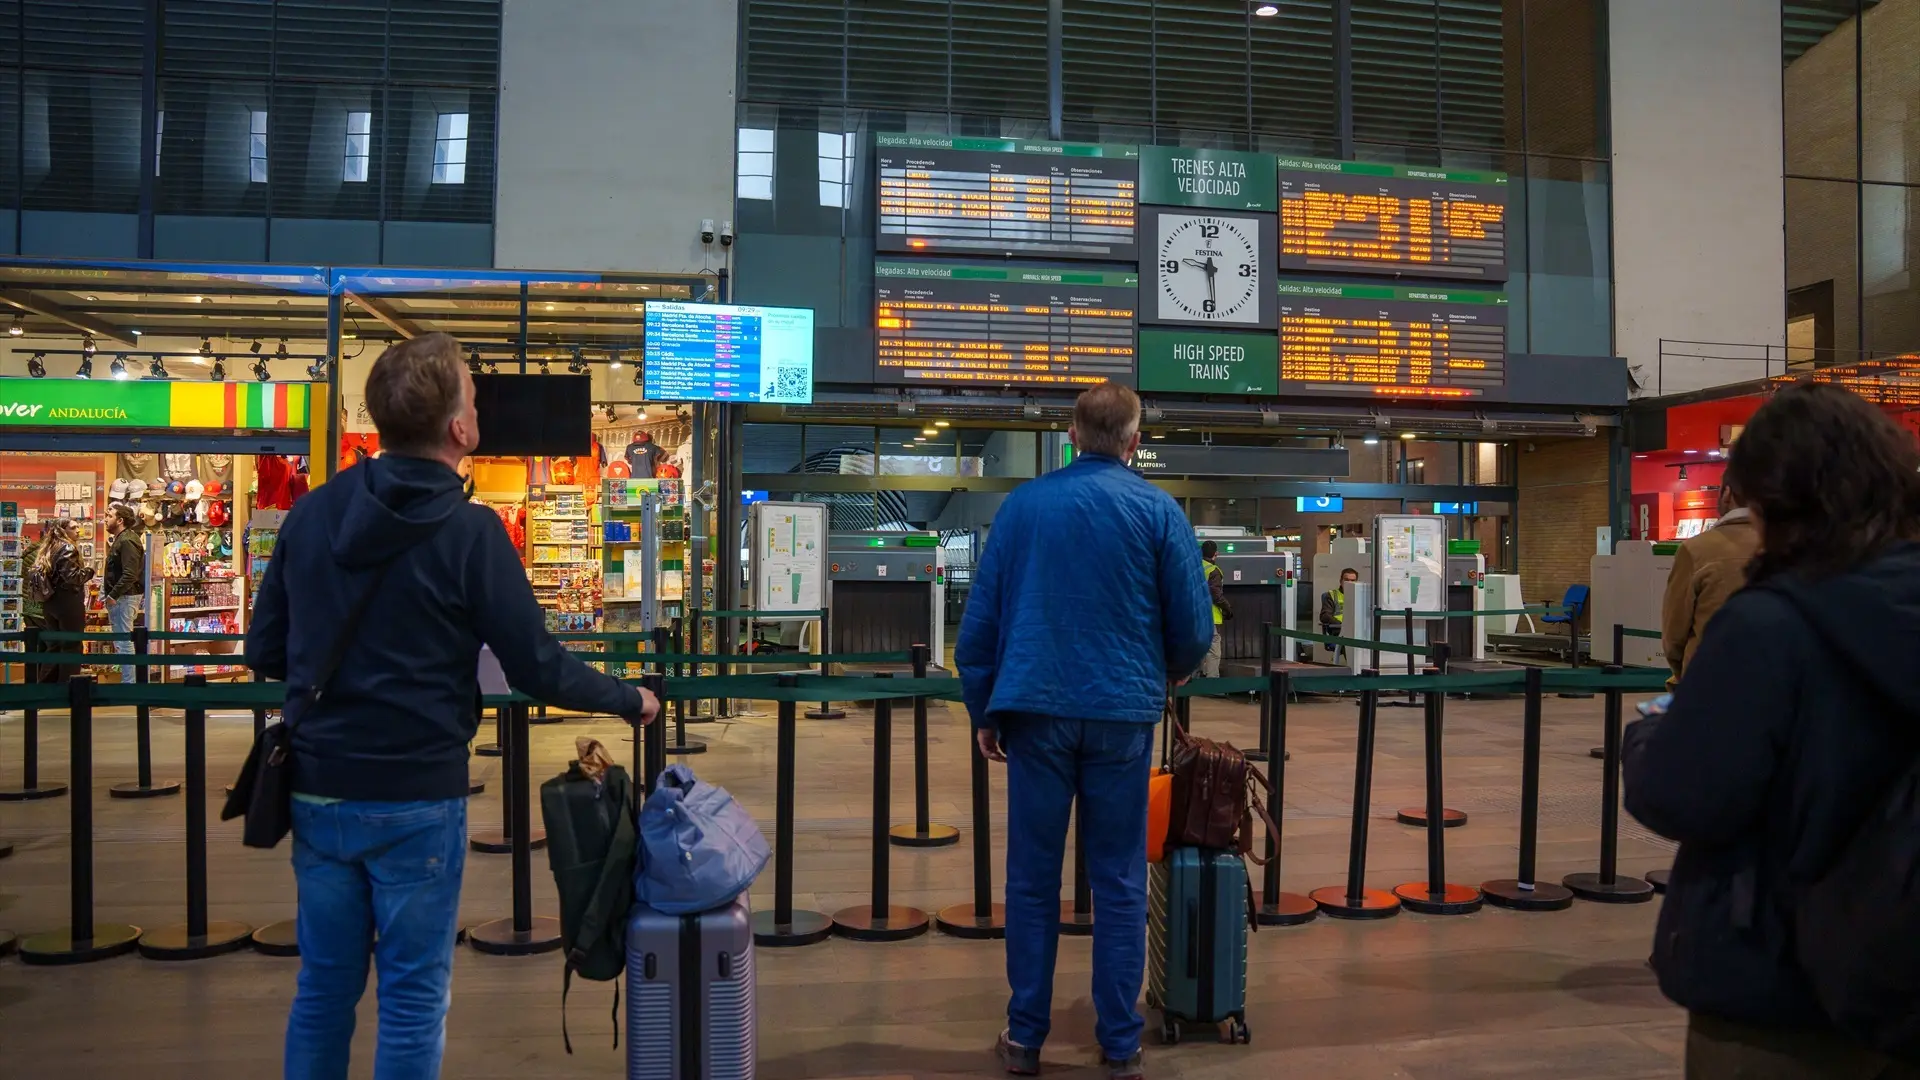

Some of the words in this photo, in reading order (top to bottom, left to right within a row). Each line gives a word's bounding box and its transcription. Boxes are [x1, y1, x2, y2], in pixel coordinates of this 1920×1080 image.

[878, 136, 908, 146] Llegadas:
[909, 137, 921, 146] Alta
[923, 138, 953, 147] velocidad
[1171, 158, 1215, 177] TRENES
[1219, 162, 1246, 179] ALTA
[1278, 158, 1301, 168] Salidas:
[1301, 160, 1313, 168] Alta
[1314, 162, 1341, 171] velocidad
[1177, 177, 1240, 196] VELOCIDAD
[1200, 225, 1219, 239] 12
[1195, 249, 1223, 257] FESTINA
[876, 266, 906, 276] Llegadas:
[907, 267, 919, 276] Alta
[921, 268, 951, 277] velocidad
[1166, 260, 1179, 274] 9
[1238, 264, 1251, 277] 3
[1279, 285, 1301, 293] Salidas:
[1302, 285, 1314, 293] Alta
[1314, 286, 1342, 295] velocidad
[1202, 299, 1216, 313] 6
[1173, 343, 1205, 361] HIGH
[1209, 345, 1245, 362] SPEED
[1188, 363, 1230, 381] TRAINS
[48, 406, 128, 419] ANDALUCÍA
[1137, 448, 1157, 460] Vías
[623, 667, 646, 675] tienda
